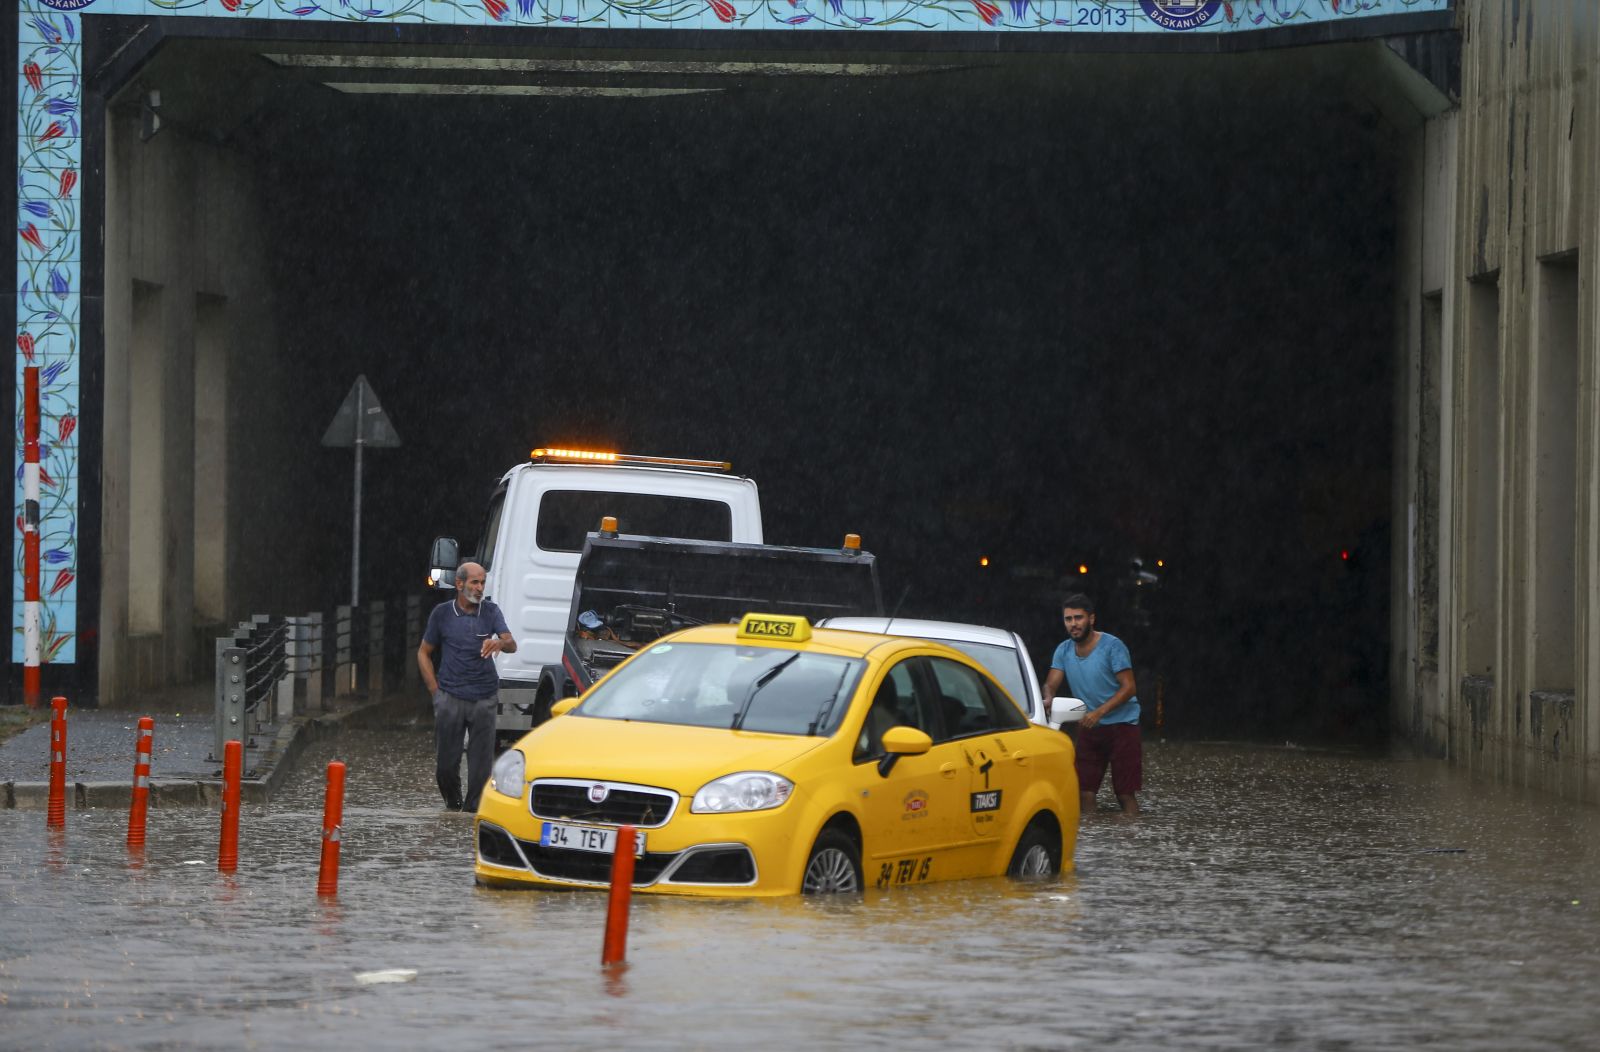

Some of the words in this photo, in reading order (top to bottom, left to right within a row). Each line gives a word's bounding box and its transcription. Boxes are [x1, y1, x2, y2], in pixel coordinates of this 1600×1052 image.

[1078, 8, 1126, 25] 2013
[551, 827, 568, 845] 34
[581, 829, 608, 849] TEV
[877, 863, 893, 889] 34
[896, 859, 918, 884] TEV
[918, 857, 933, 881] 15
